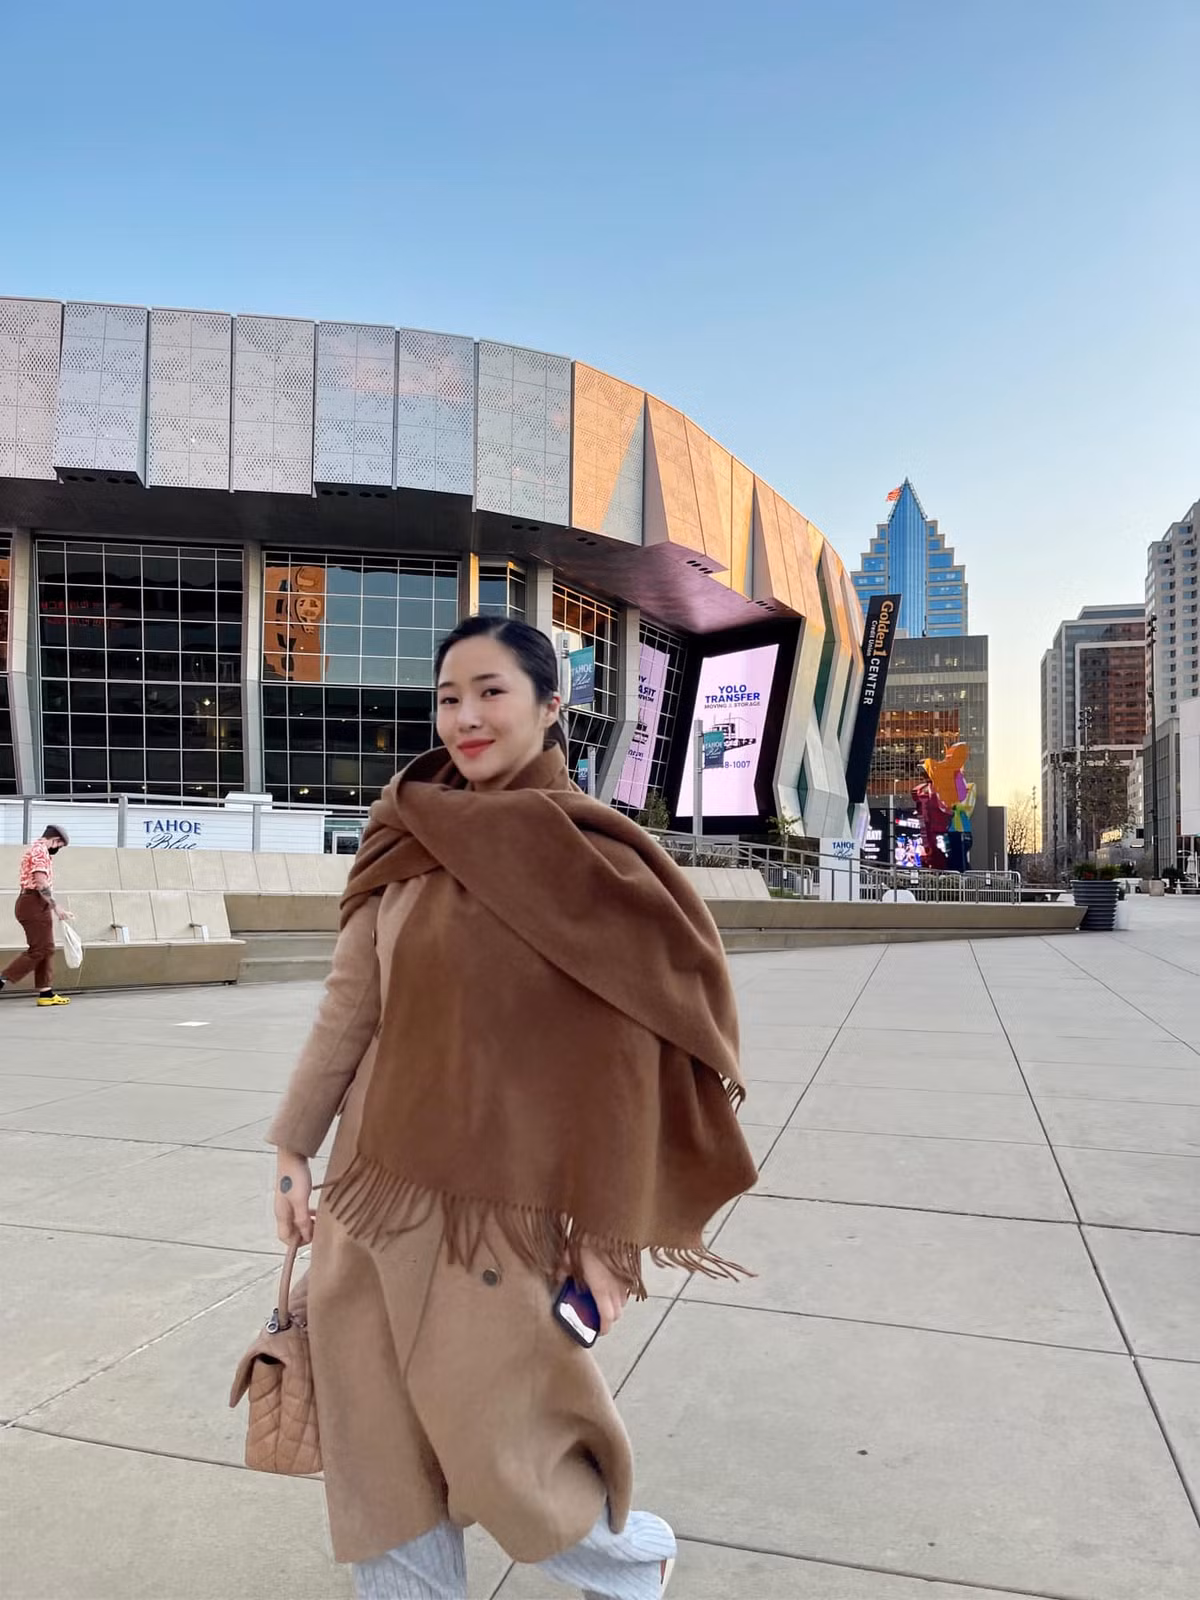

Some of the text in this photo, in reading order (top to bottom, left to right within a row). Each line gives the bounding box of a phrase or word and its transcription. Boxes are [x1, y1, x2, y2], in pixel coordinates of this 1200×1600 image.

[866, 620, 878, 657] Credit Union
[863, 658, 880, 705] CENTER
[718, 684, 747, 694] YOLO
[704, 692, 761, 704] TRANSFER
[724, 760, 751, 769] 8-1007
[143, 819, 202, 835] TAHOE
[145, 833, 197, 849] Blue
[831, 841, 855, 850] TAHOE
